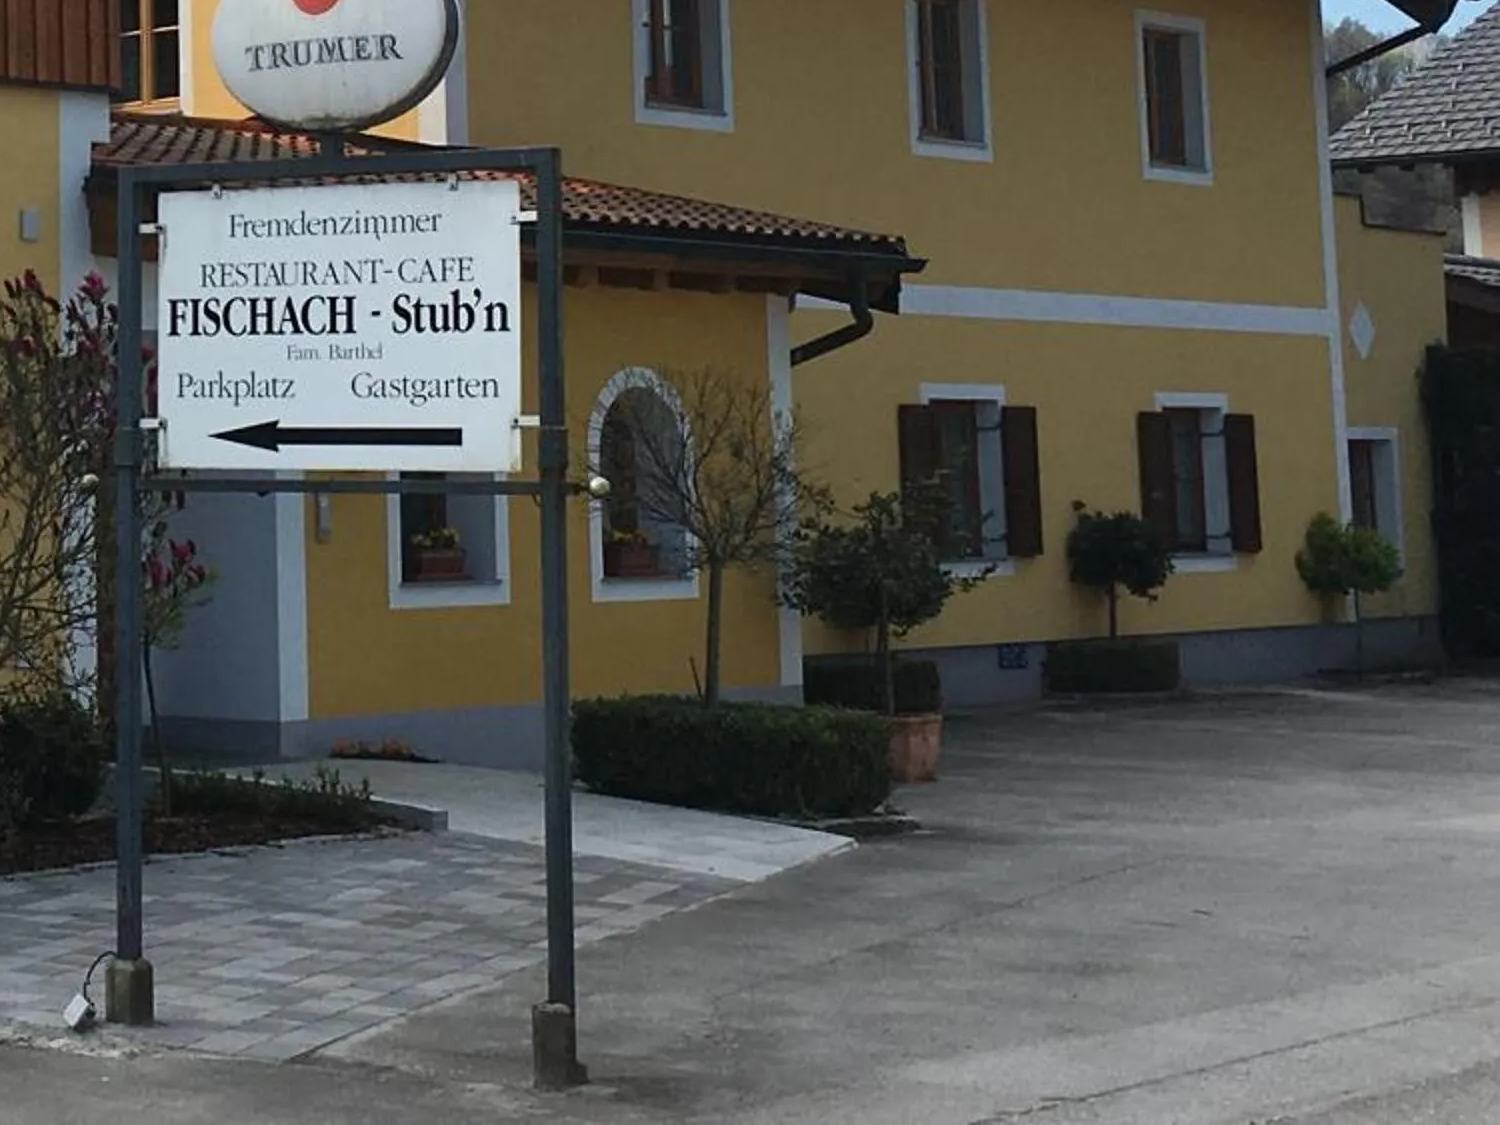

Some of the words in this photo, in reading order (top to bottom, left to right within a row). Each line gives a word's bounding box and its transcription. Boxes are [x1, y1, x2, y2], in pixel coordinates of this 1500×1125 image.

[245, 34, 403, 71] TRUMER
[229, 210, 442, 240] Fremdenzimmer
[168, 295, 357, 337] FISCHACH
[392, 288, 511, 334] Stub'n
[329, 343, 384, 361] Barthel
[177, 370, 296, 406] Parkplatz
[351, 372, 501, 406] Gastgarten
